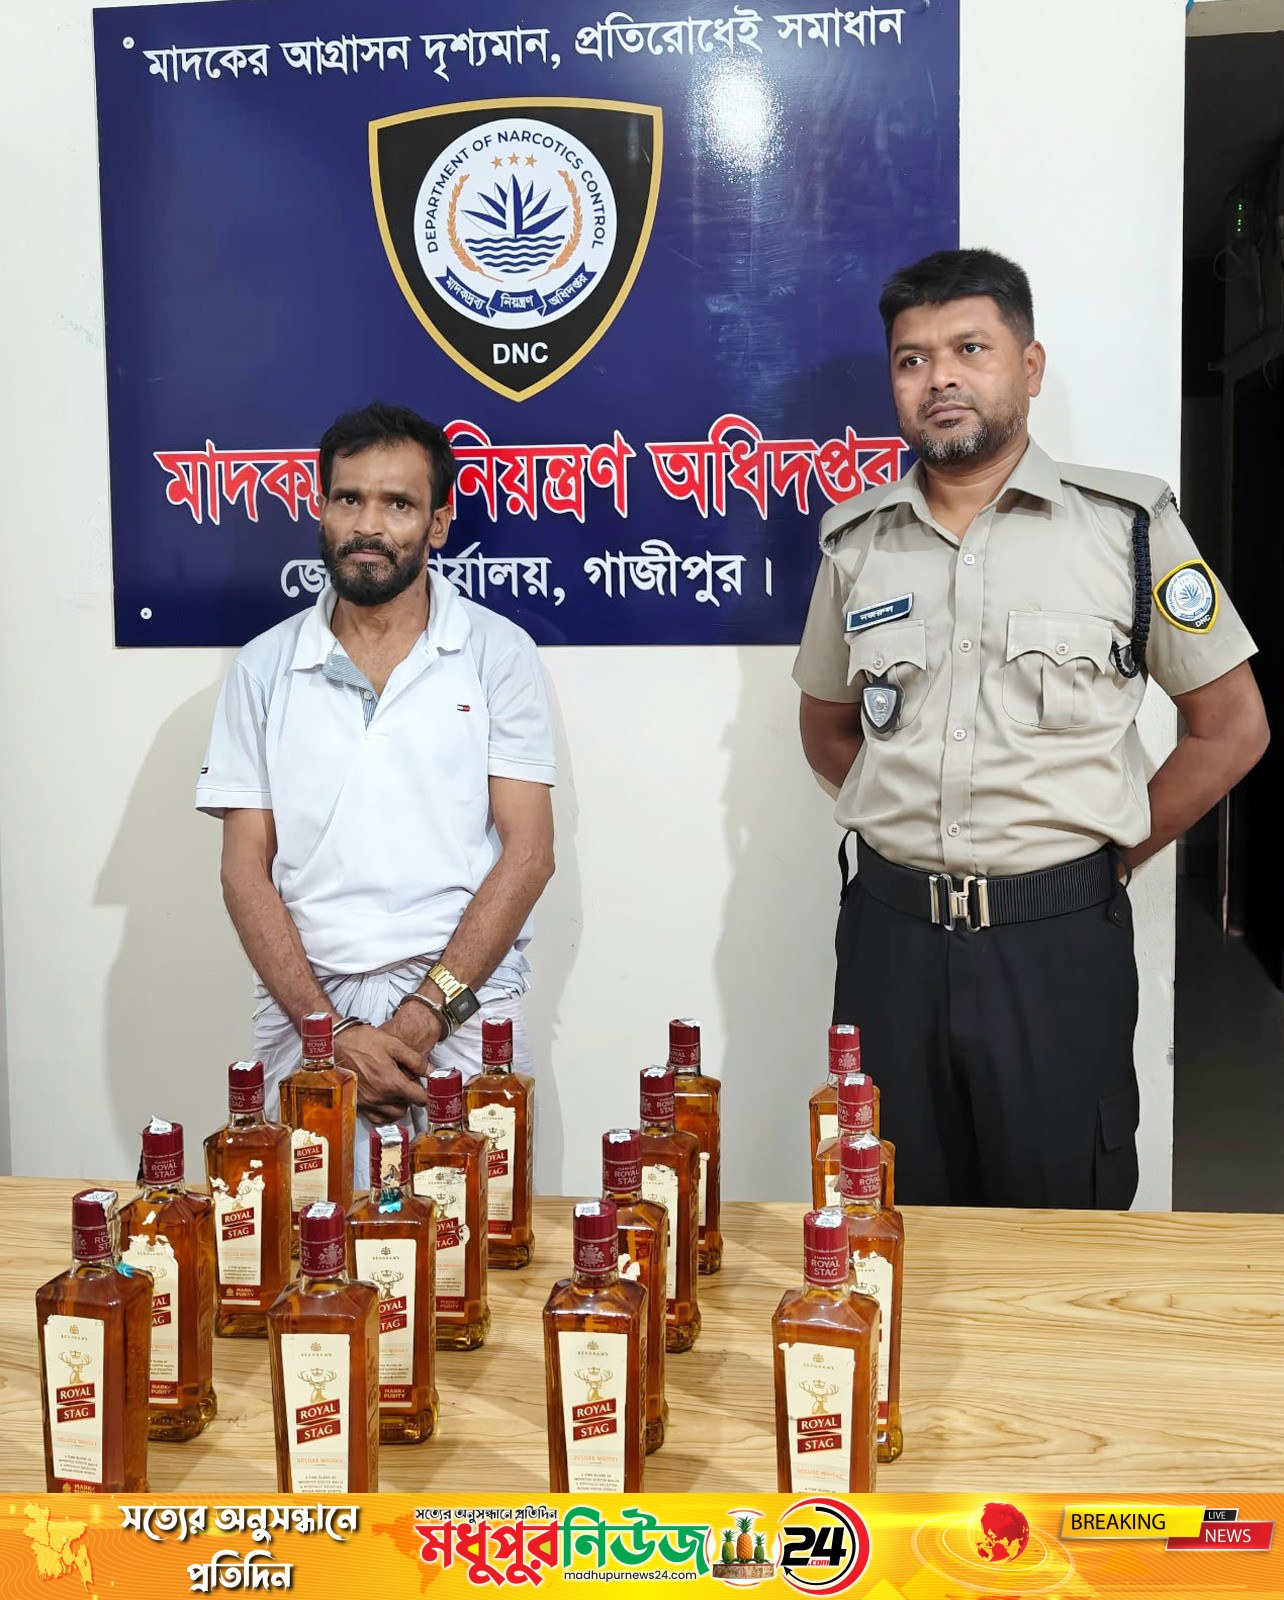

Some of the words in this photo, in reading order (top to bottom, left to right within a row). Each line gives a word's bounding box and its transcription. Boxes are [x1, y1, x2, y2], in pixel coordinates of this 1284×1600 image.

[145, 41, 269, 82] মাদকের
[280, 34, 411, 74] আগ্রাসন
[423, 25, 562, 82] দৃশ্যমান,
[574, 14, 765, 58] প্রতিরোধেই
[776, 8, 905, 48] সমাধান
[425, 147, 470, 253] DEPARTMENT
[473, 134, 493, 152] OF
[497, 130, 584, 168] NARCOTICS
[581, 170, 606, 250] CONTROL
[492, 342, 549, 364] DNC
[584, 538, 747, 607] গাজীপুর
[1195, 614, 1211, 628] DNC
[296, 1146, 321, 1157] ROYAL
[488, 1153, 506, 1163] OYAL
[151, 1161, 178, 1171] ROYAL
[299, 1160, 319, 1171] STAG
[488, 1167, 504, 1176] TAG
[154, 1170, 176, 1179] STAG
[614, 1169, 640, 1178] ROYAL
[224, 1211, 252, 1225] ROYAL
[227, 1226, 250, 1239] STAG
[436, 1221, 456, 1232] OYAL
[436, 1237, 454, 1248] TAG
[811, 1258, 841, 1269] ROYAL
[814, 1267, 838, 1277] STAG
[152, 1296, 168, 1307] YAL
[379, 1300, 404, 1314] OYAL
[152, 1315, 165, 1326] AG
[380, 1318, 401, 1331] TAG
[60, 1386, 92, 1400] ROYAL
[64, 1408, 90, 1420] STAG
[300, 1403, 337, 1420] ROYAL
[577, 1402, 612, 1418] ROYAL
[580, 1423, 610, 1437] STAG
[801, 1417, 838, 1431] ROYAL
[304, 1424, 334, 1440] STAG
[805, 1438, 834, 1451] STAG
